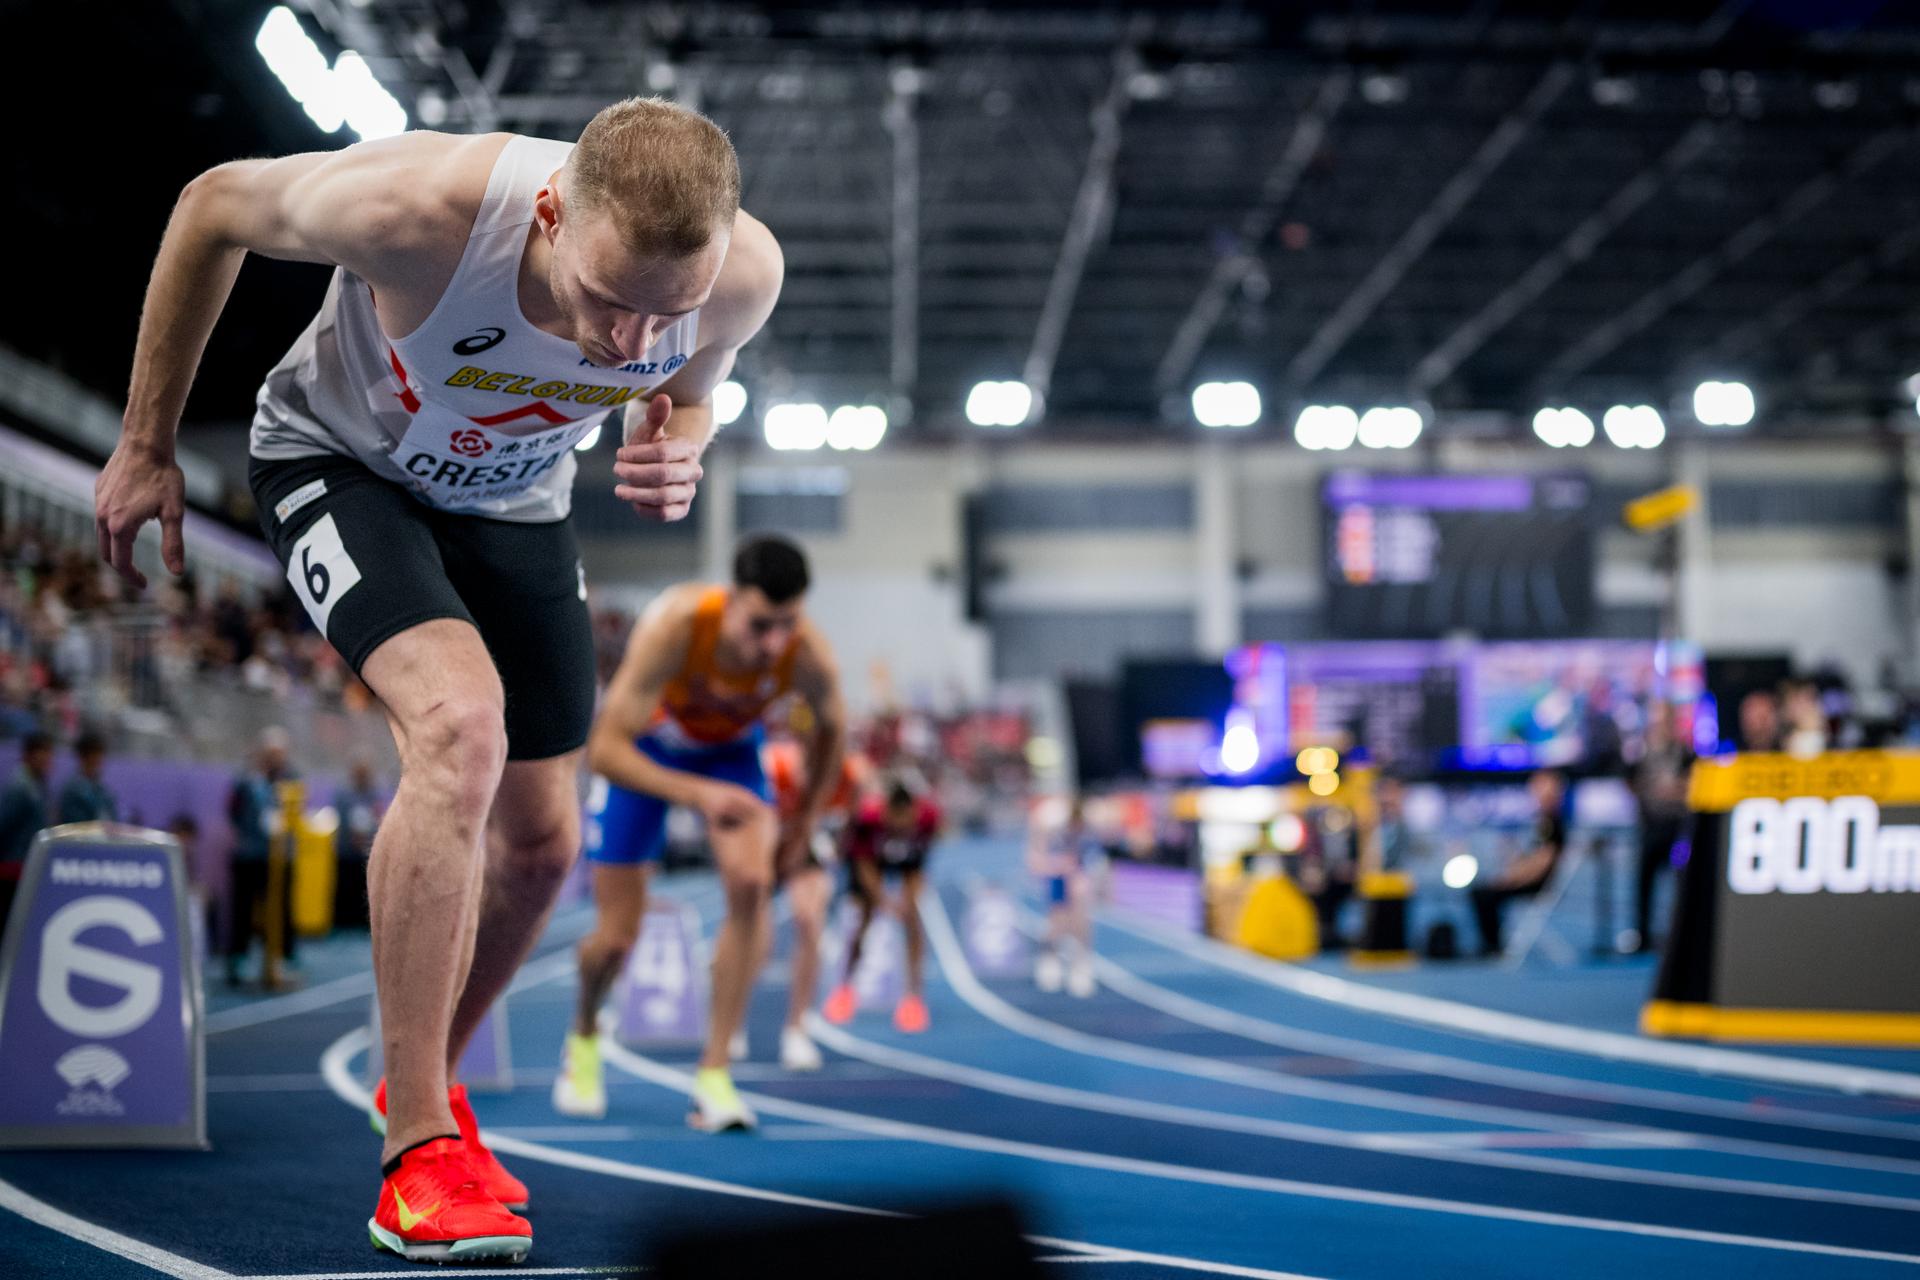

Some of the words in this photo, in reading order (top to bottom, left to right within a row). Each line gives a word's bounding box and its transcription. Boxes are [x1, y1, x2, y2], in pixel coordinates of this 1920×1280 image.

[444, 366, 650, 407] BELGIUM
[301, 545, 331, 605] 6
[51, 858, 164, 888] MONDO
[1729, 796, 1920, 893] 800m
[38, 895, 163, 1037] 6
